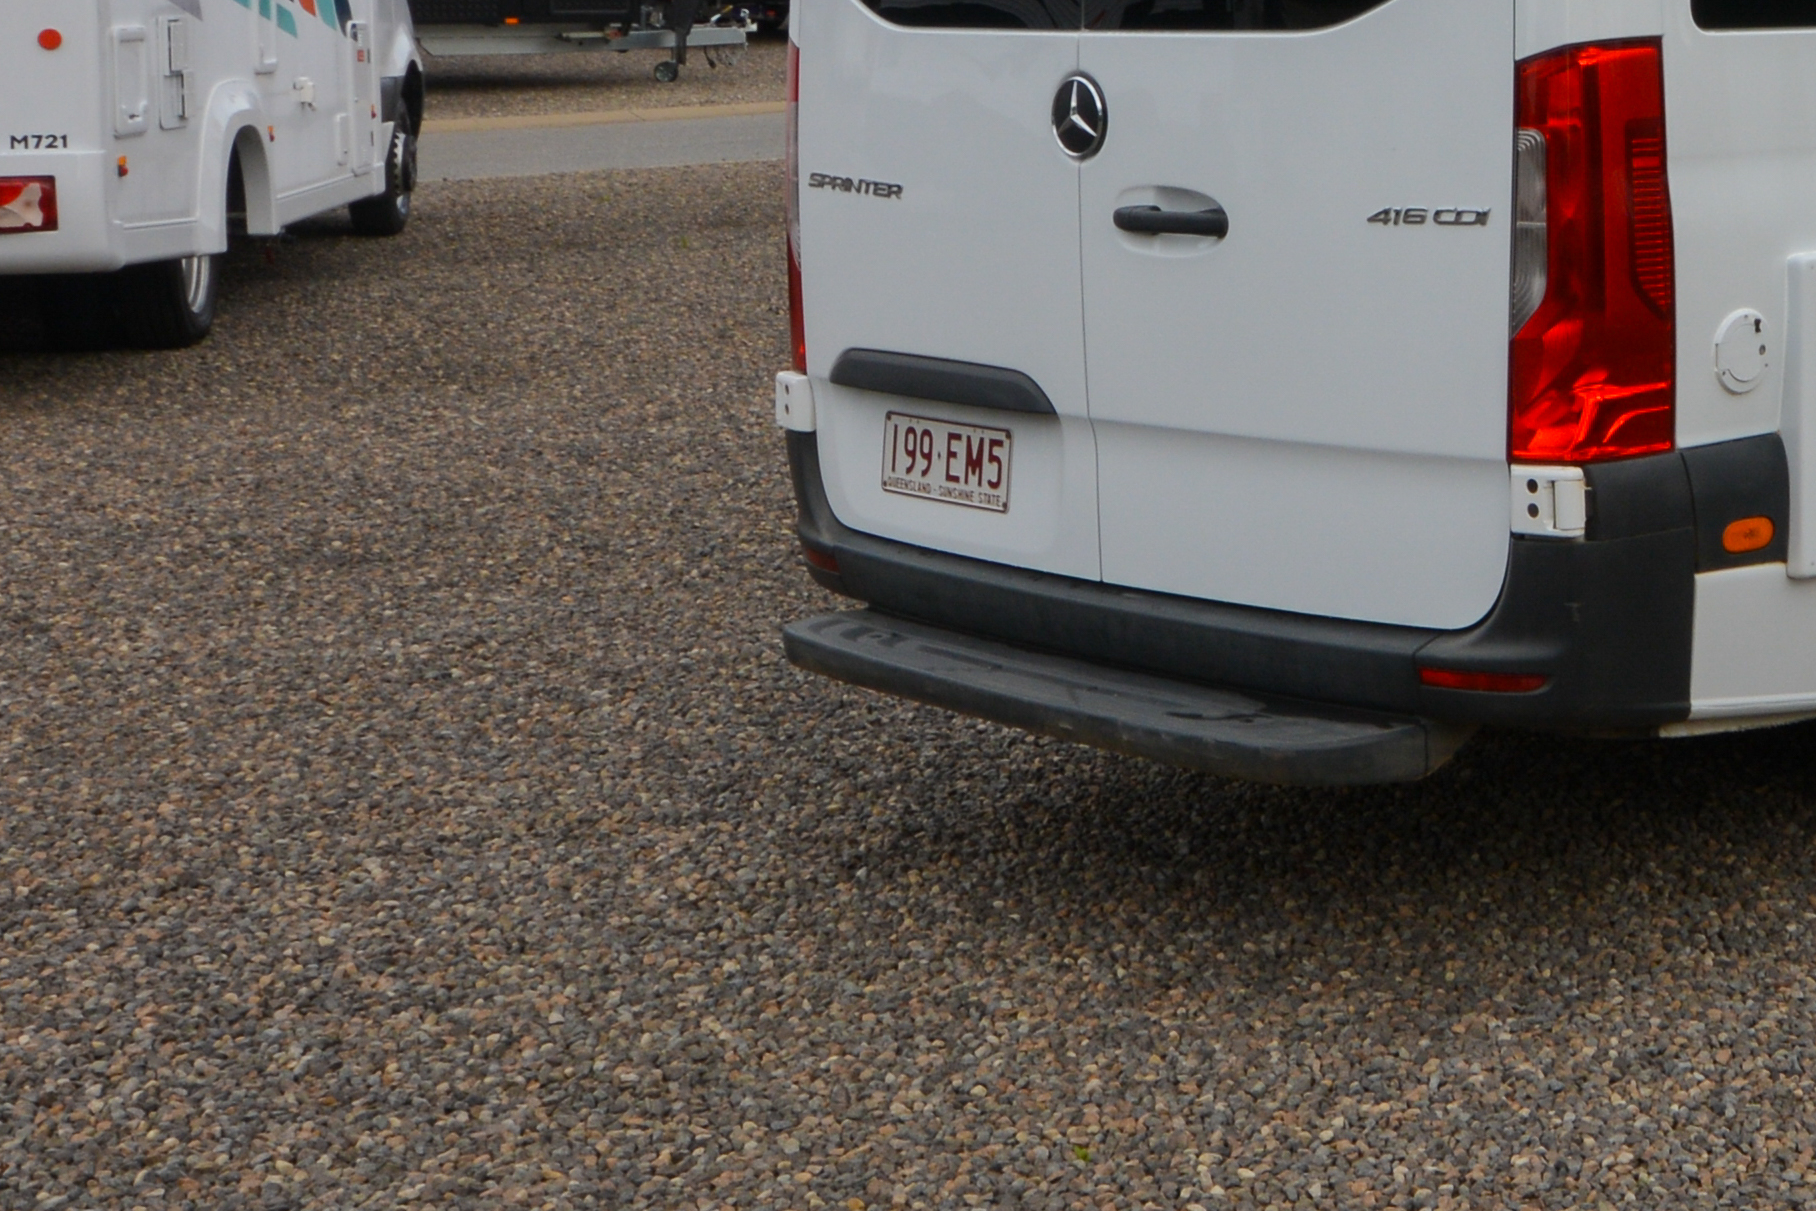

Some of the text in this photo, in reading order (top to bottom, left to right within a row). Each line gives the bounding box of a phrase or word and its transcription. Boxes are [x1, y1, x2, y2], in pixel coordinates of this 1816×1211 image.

[10, 134, 68, 150] M721
[808, 172, 904, 199] SPRINTER
[1366, 207, 1492, 226] 416 CDI
[887, 476, 932, 494] QUEENSLAND
[938, 485, 975, 502] SUNSHINE
[978, 492, 1003, 507] STATE
